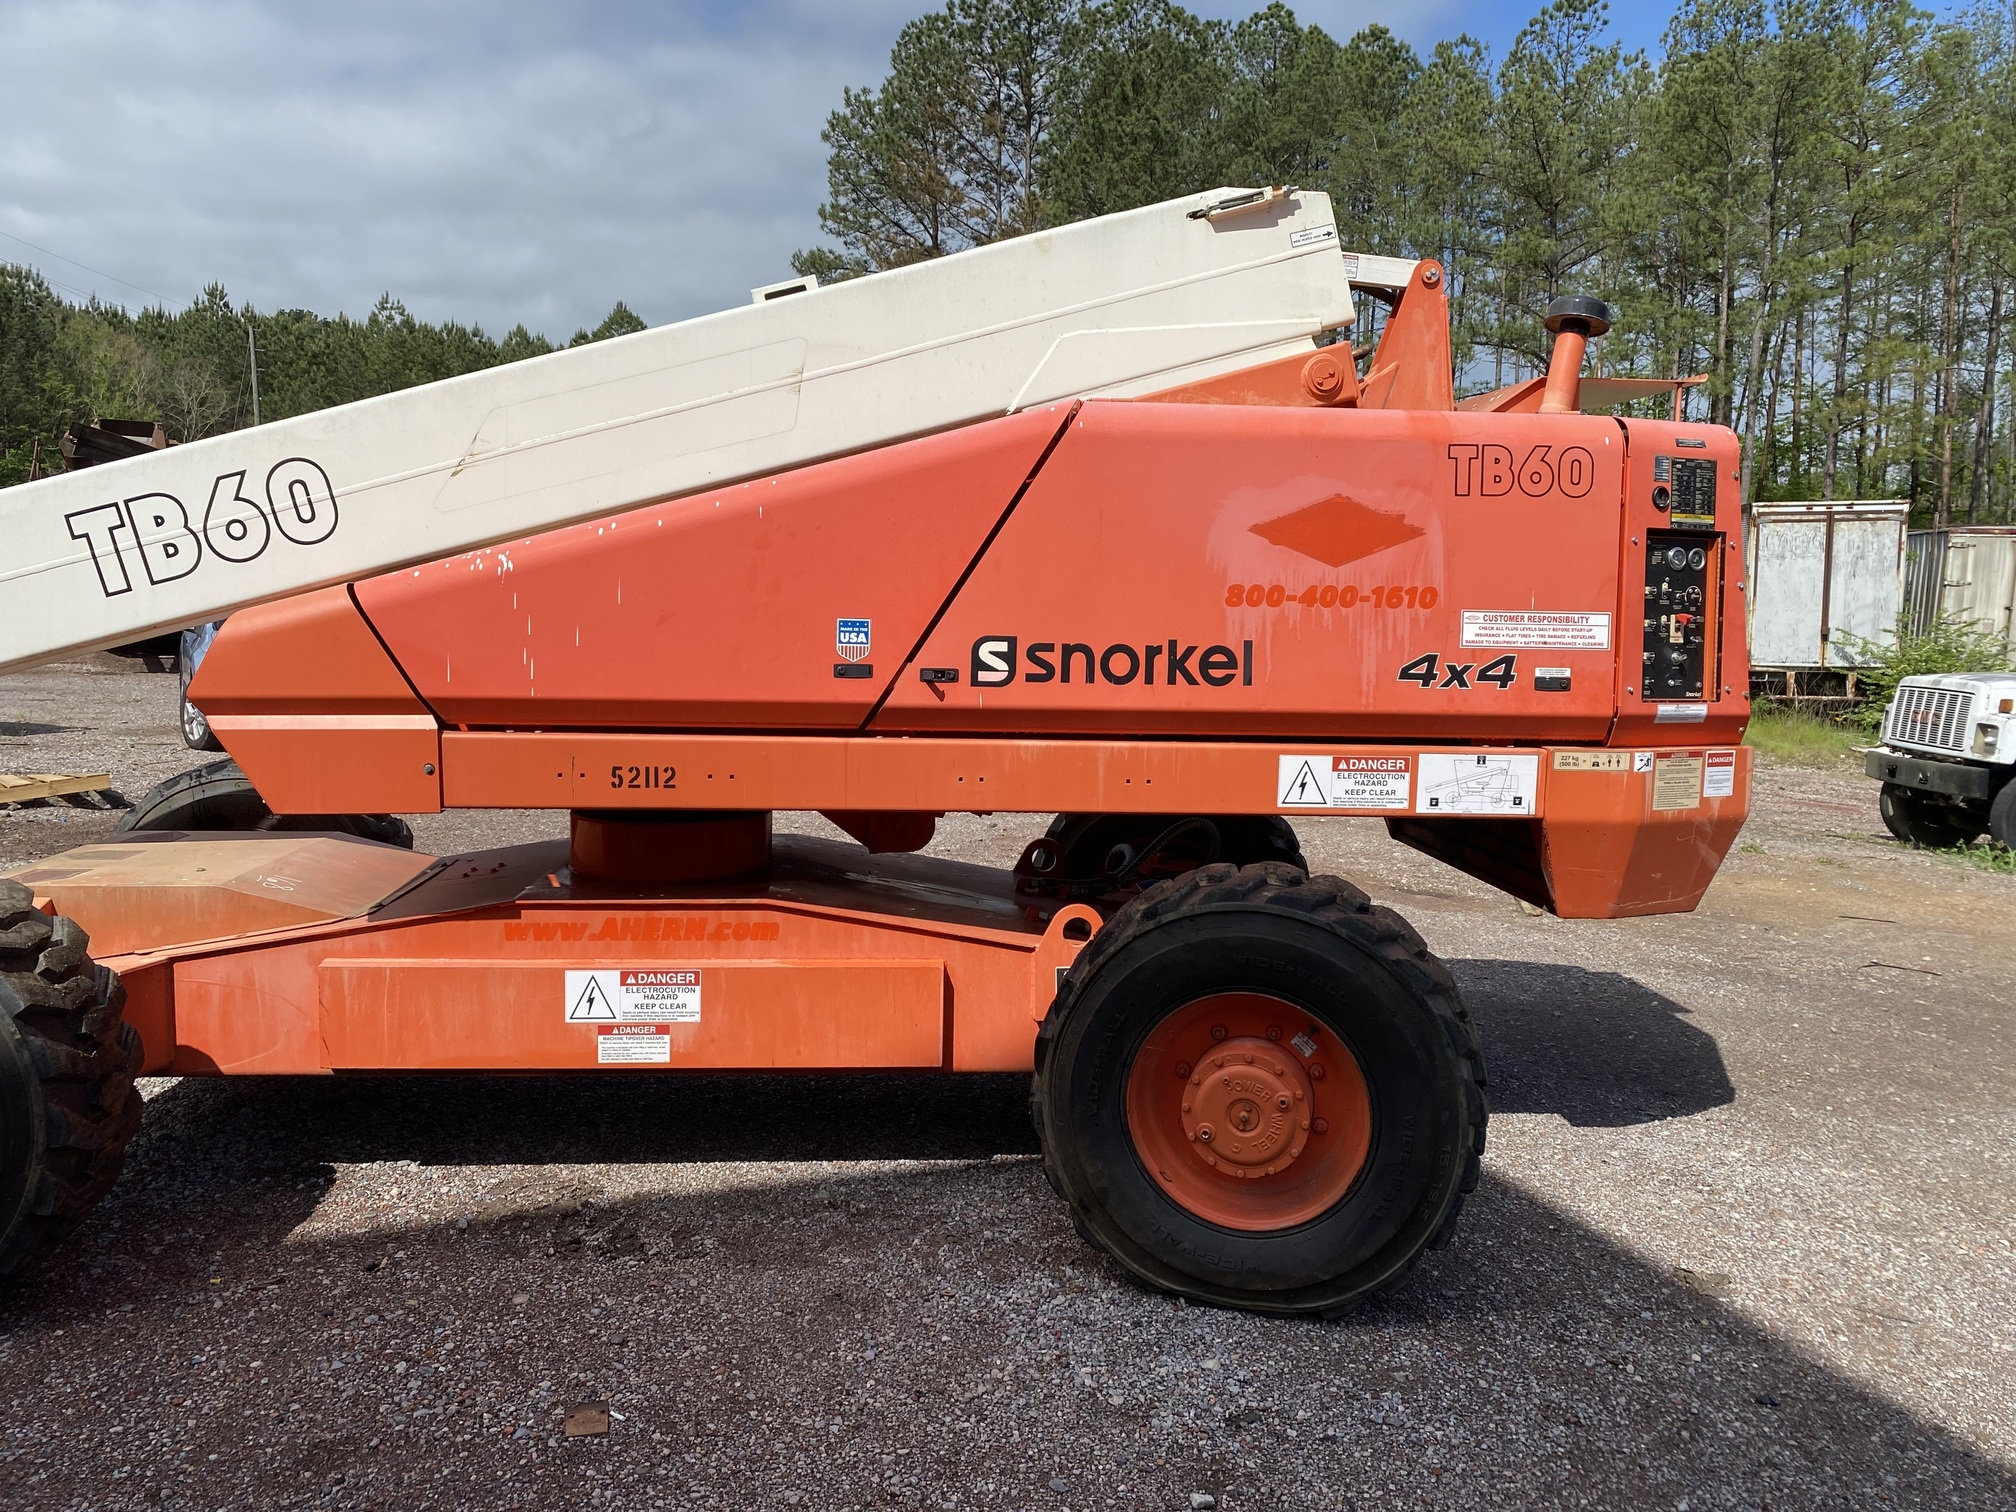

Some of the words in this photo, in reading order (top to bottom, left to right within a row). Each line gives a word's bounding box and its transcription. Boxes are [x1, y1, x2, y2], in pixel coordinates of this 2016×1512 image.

[1448, 444, 1594, 498] TB60
[64, 457, 339, 598] TB60
[1225, 584, 1438, 609] 800-400-1610
[1483, 614, 1526, 623] CUSTOMER
[1527, 615, 1590, 624] RESPONSIBILITY
[840, 632, 867, 643] USA
[1025, 639, 1253, 686] snorkel
[1396, 653, 1518, 690] 4x4
[1337, 772, 1406, 780] ELECTROCUTION
[1349, 759, 1405, 770] DANGER
[611, 766, 676, 788] 52112
[504, 917, 780, 942] www.AHERN.com
[638, 973, 695, 984] DANGER
[620, 1026, 656, 1034] DANGER
[1227, 1080, 1271, 1103] POWER
[1251, 1113, 1283, 1153] WHEEL
